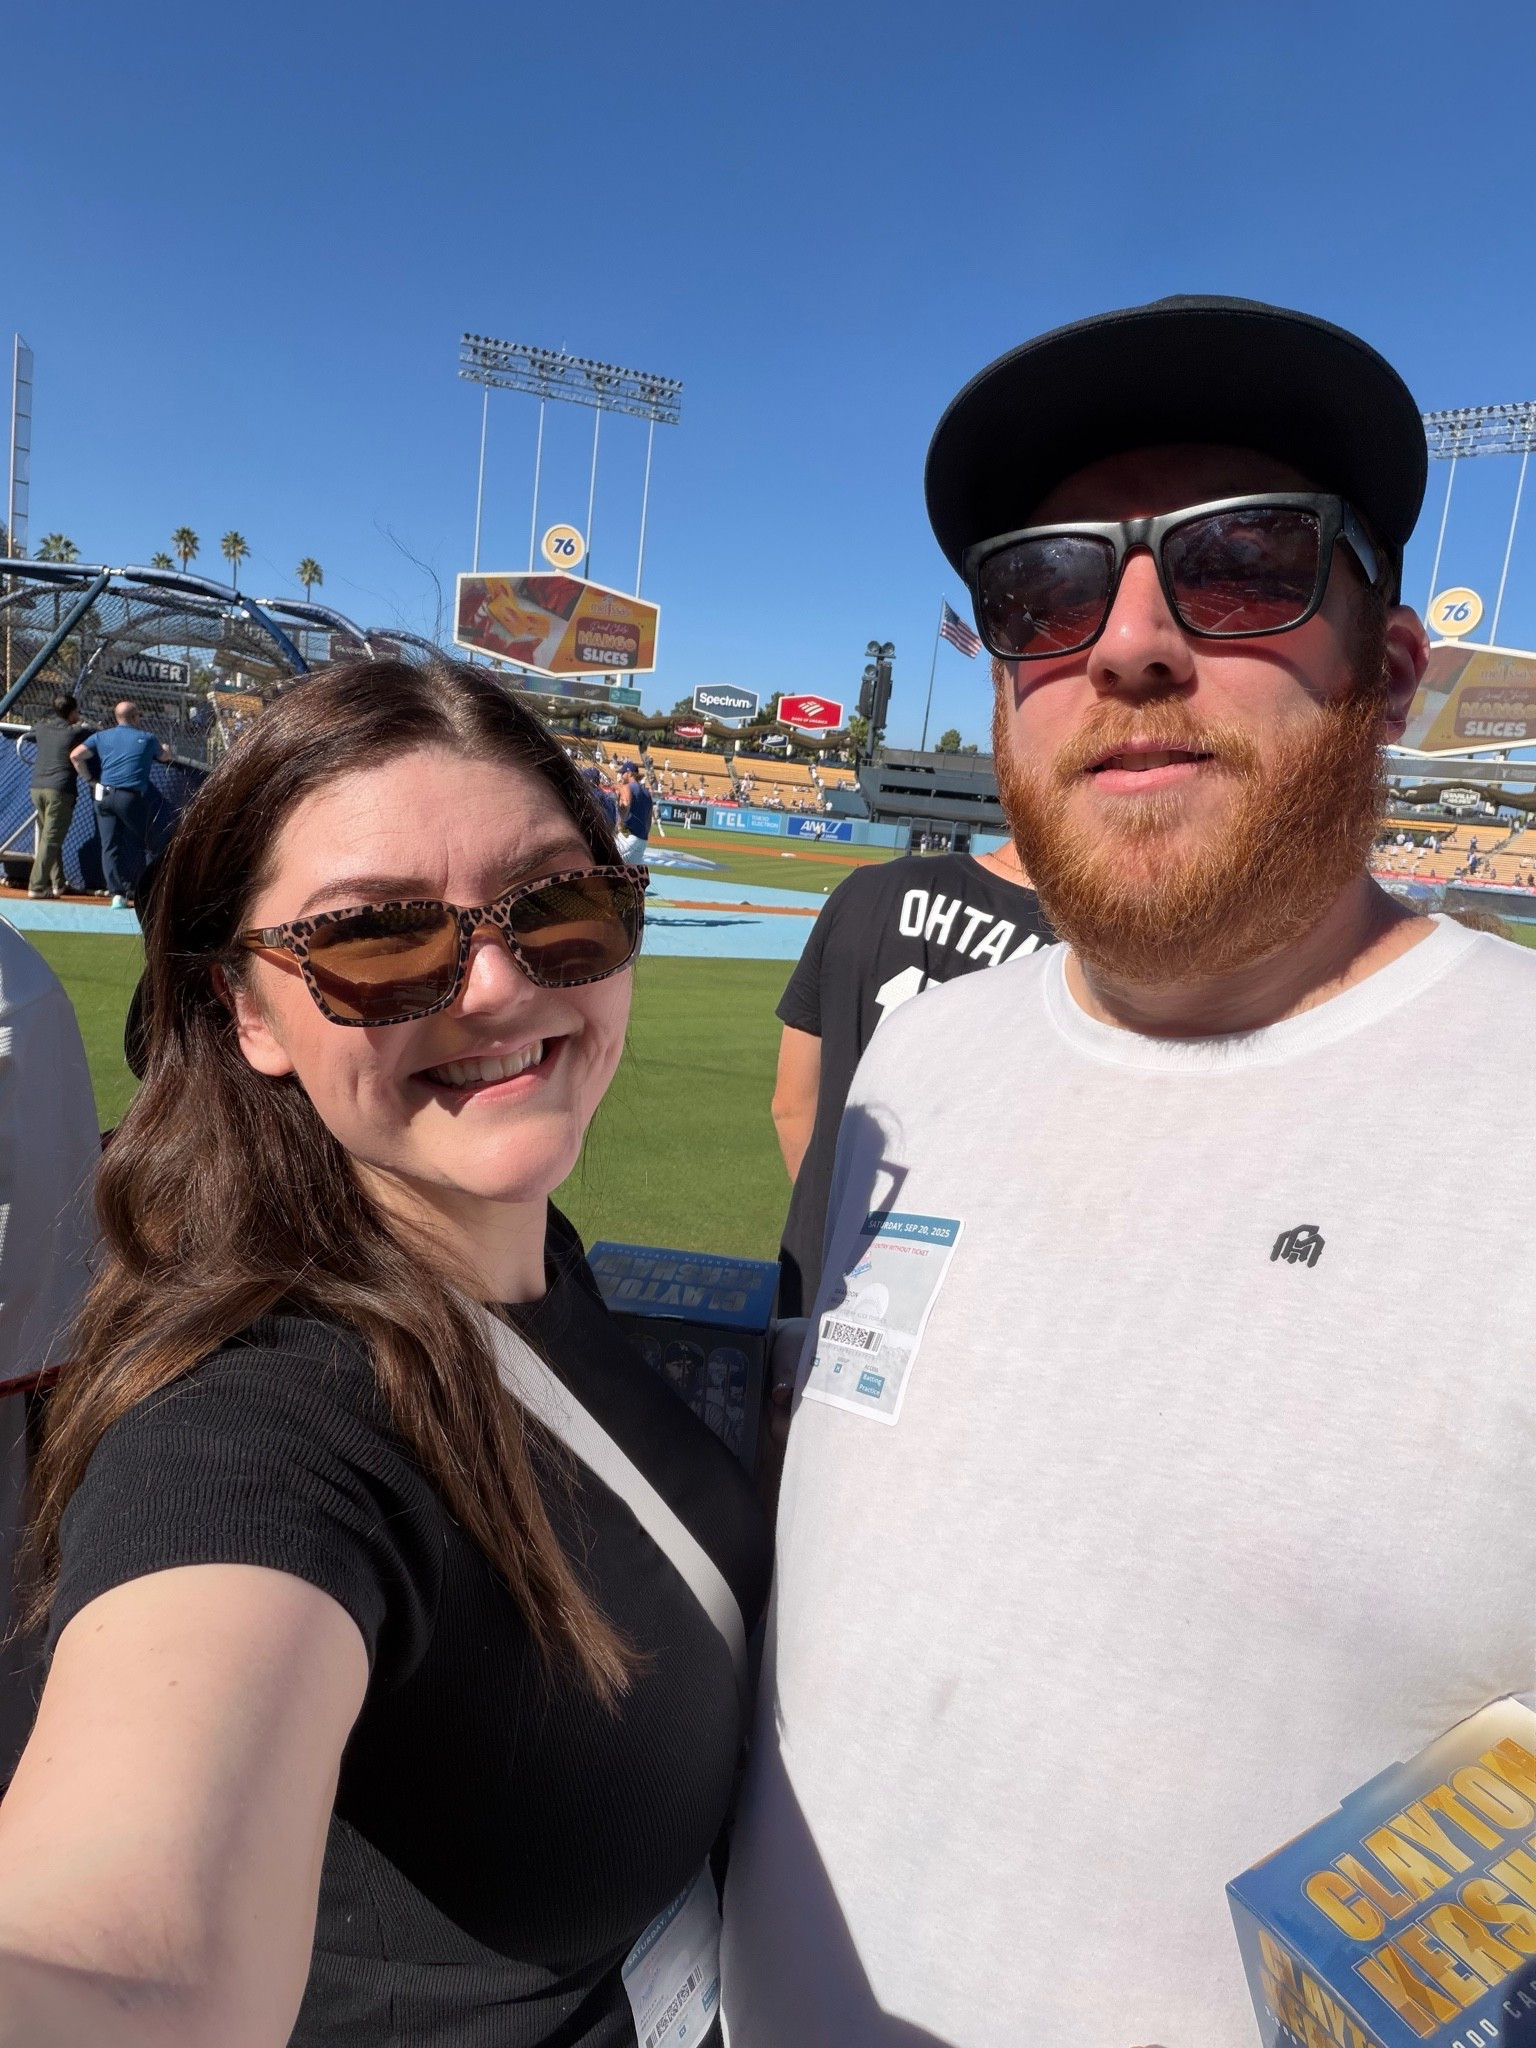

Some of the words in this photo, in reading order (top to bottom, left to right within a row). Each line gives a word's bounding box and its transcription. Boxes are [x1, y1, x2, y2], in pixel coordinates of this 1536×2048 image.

[552, 538, 576, 556] 76
[1442, 602, 1471, 622] 76
[578, 630, 637, 652] MANGO
[582, 647, 629, 666] SLICES
[122, 659, 181, 681] WATER
[699, 692, 750, 709] Spectrum
[1464, 720, 1527, 737] SLICES
[673, 808, 702, 820] Heth
[716, 810, 745, 828] TEL
[751, 814, 770, 822] TOKYO
[751, 820, 779, 828] ELECTRON
[800, 820, 827, 833] ANA
[868, 1220, 903, 1233] SATURDAY,
[904, 1223, 918, 1232] SEP
[918, 1225, 929, 1235] 20,
[930, 1227, 951, 1238] 2025
[889, 1244, 911, 1253] WITHOUT
[911, 1248, 930, 1257] TICKET
[592, 1254, 763, 1290] KERSHAW
[597, 1275, 748, 1313] CLAYTON
[862, 1374, 882, 1387] Batting
[859, 1384, 880, 1396] Practice
[627, 1917, 667, 1967] SATURDAY,
[1351, 1832, 1536, 2038] KERS
[1258, 1930, 1377, 2048] CLAYT
